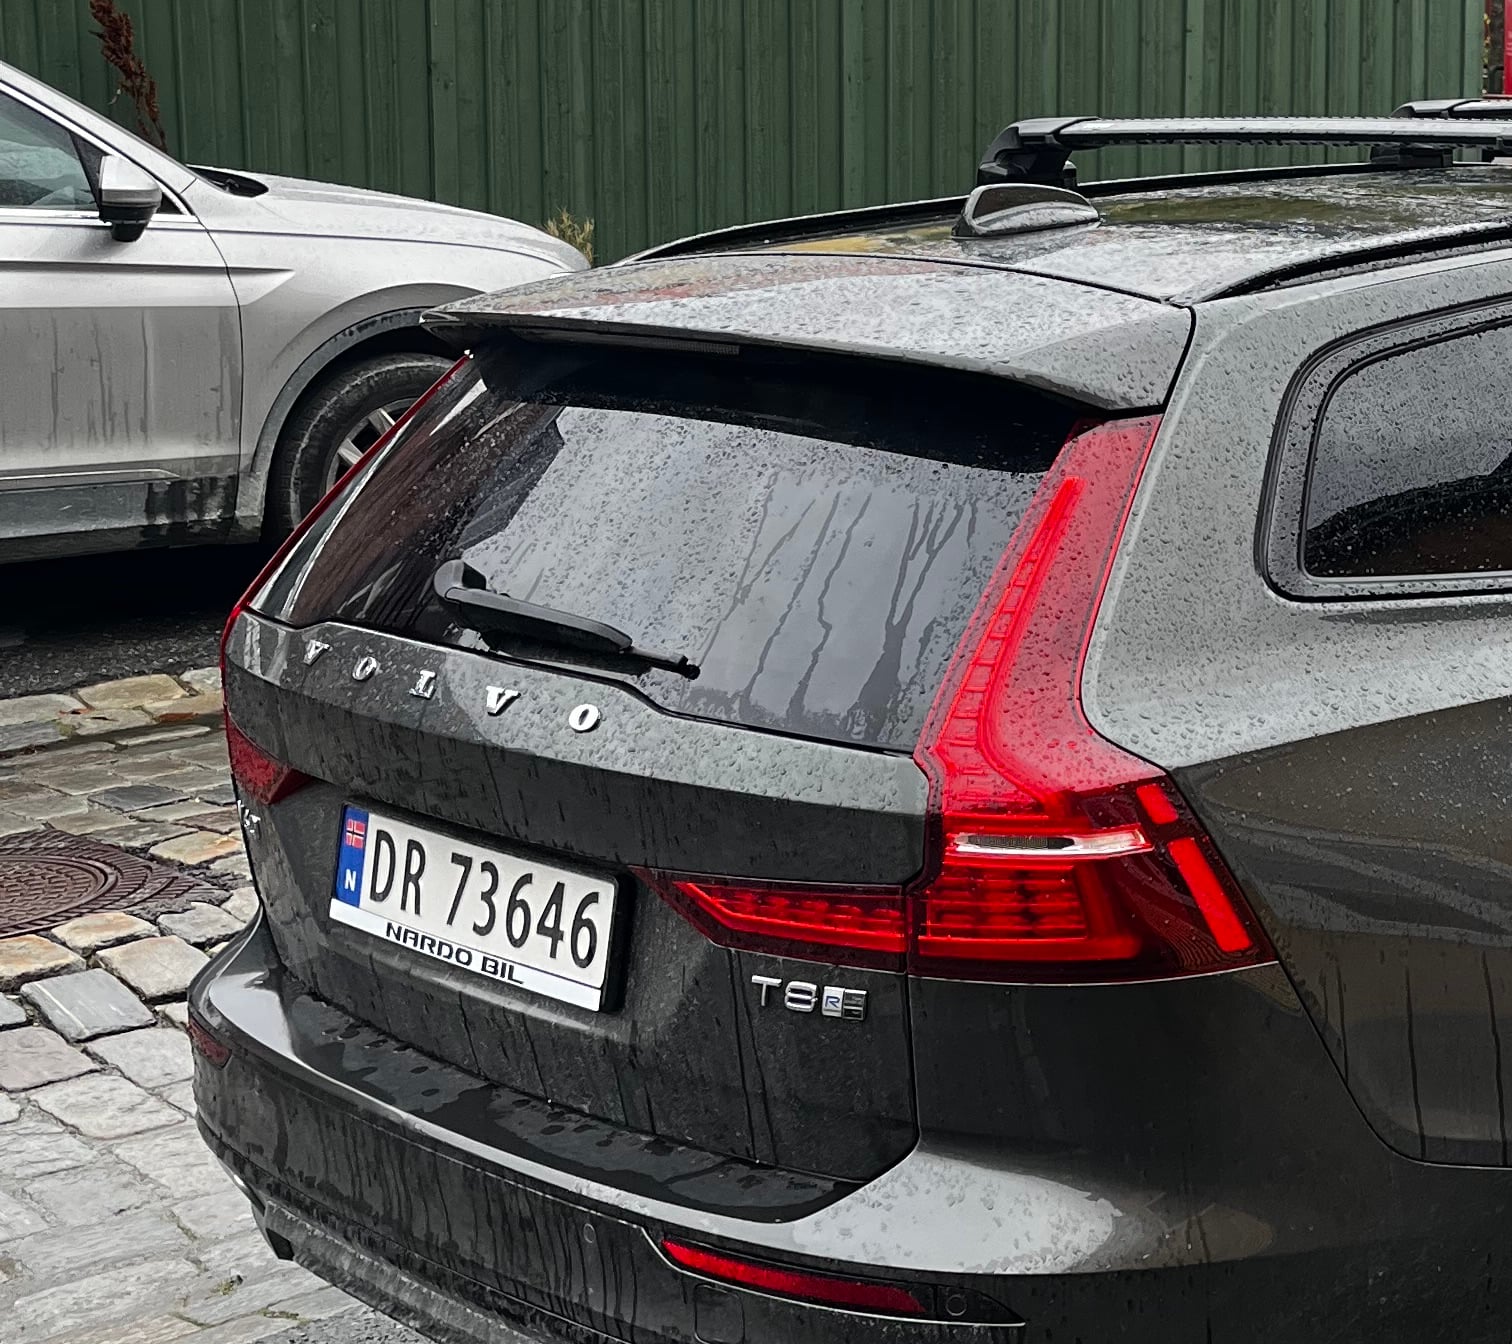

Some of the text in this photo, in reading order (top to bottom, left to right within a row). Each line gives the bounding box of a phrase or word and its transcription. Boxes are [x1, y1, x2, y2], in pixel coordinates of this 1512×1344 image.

[303, 639, 600, 733] VOLVO
[344, 868, 356, 893] N
[369, 829, 600, 970] DR 73646
[385, 921, 525, 985] NARDO BIL
